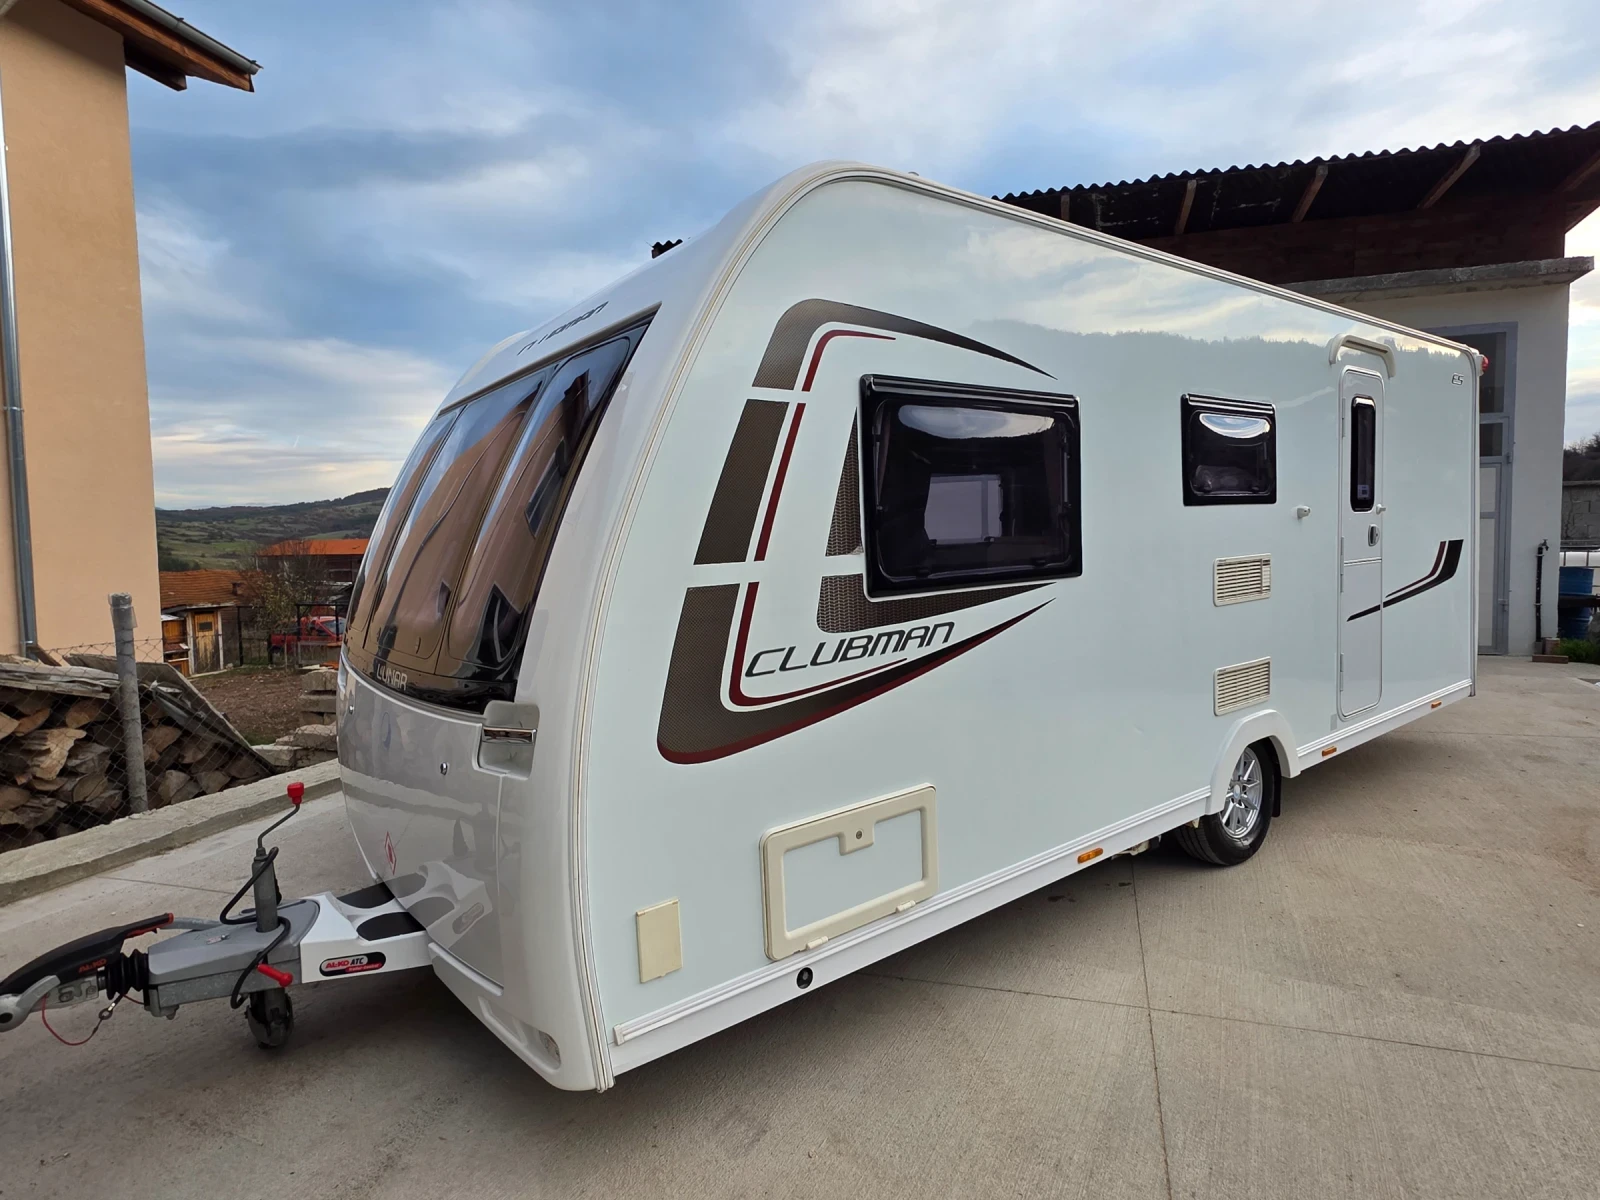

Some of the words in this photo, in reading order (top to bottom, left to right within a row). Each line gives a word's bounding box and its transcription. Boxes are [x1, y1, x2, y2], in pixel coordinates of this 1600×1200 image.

[744, 621, 955, 678] CLUBMAN
[376, 663, 408, 691] LUNAR
[325, 959, 350, 969] AL-KO
[350, 957, 365, 966] ATC
